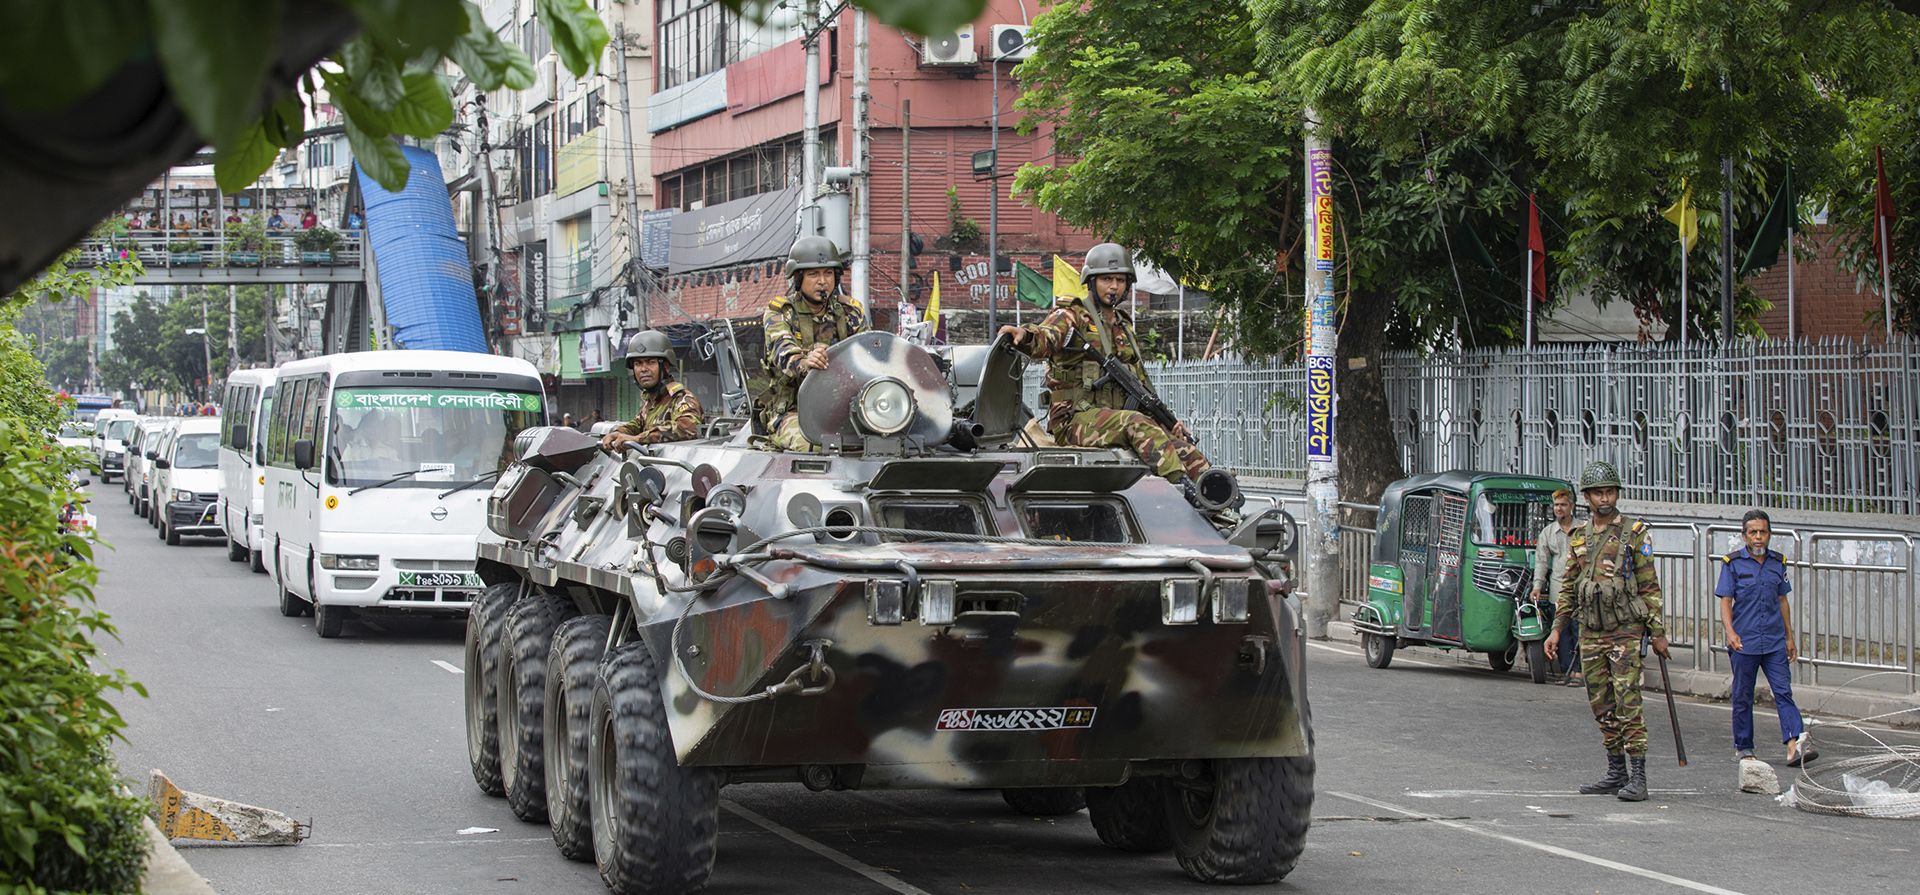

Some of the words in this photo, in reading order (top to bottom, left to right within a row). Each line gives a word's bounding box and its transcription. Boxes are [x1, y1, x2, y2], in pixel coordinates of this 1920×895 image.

[1309, 357, 1333, 369] BCS
[355, 393, 434, 407] বাংলাদেশ
[438, 393, 523, 409] সেনাবাহিনী
